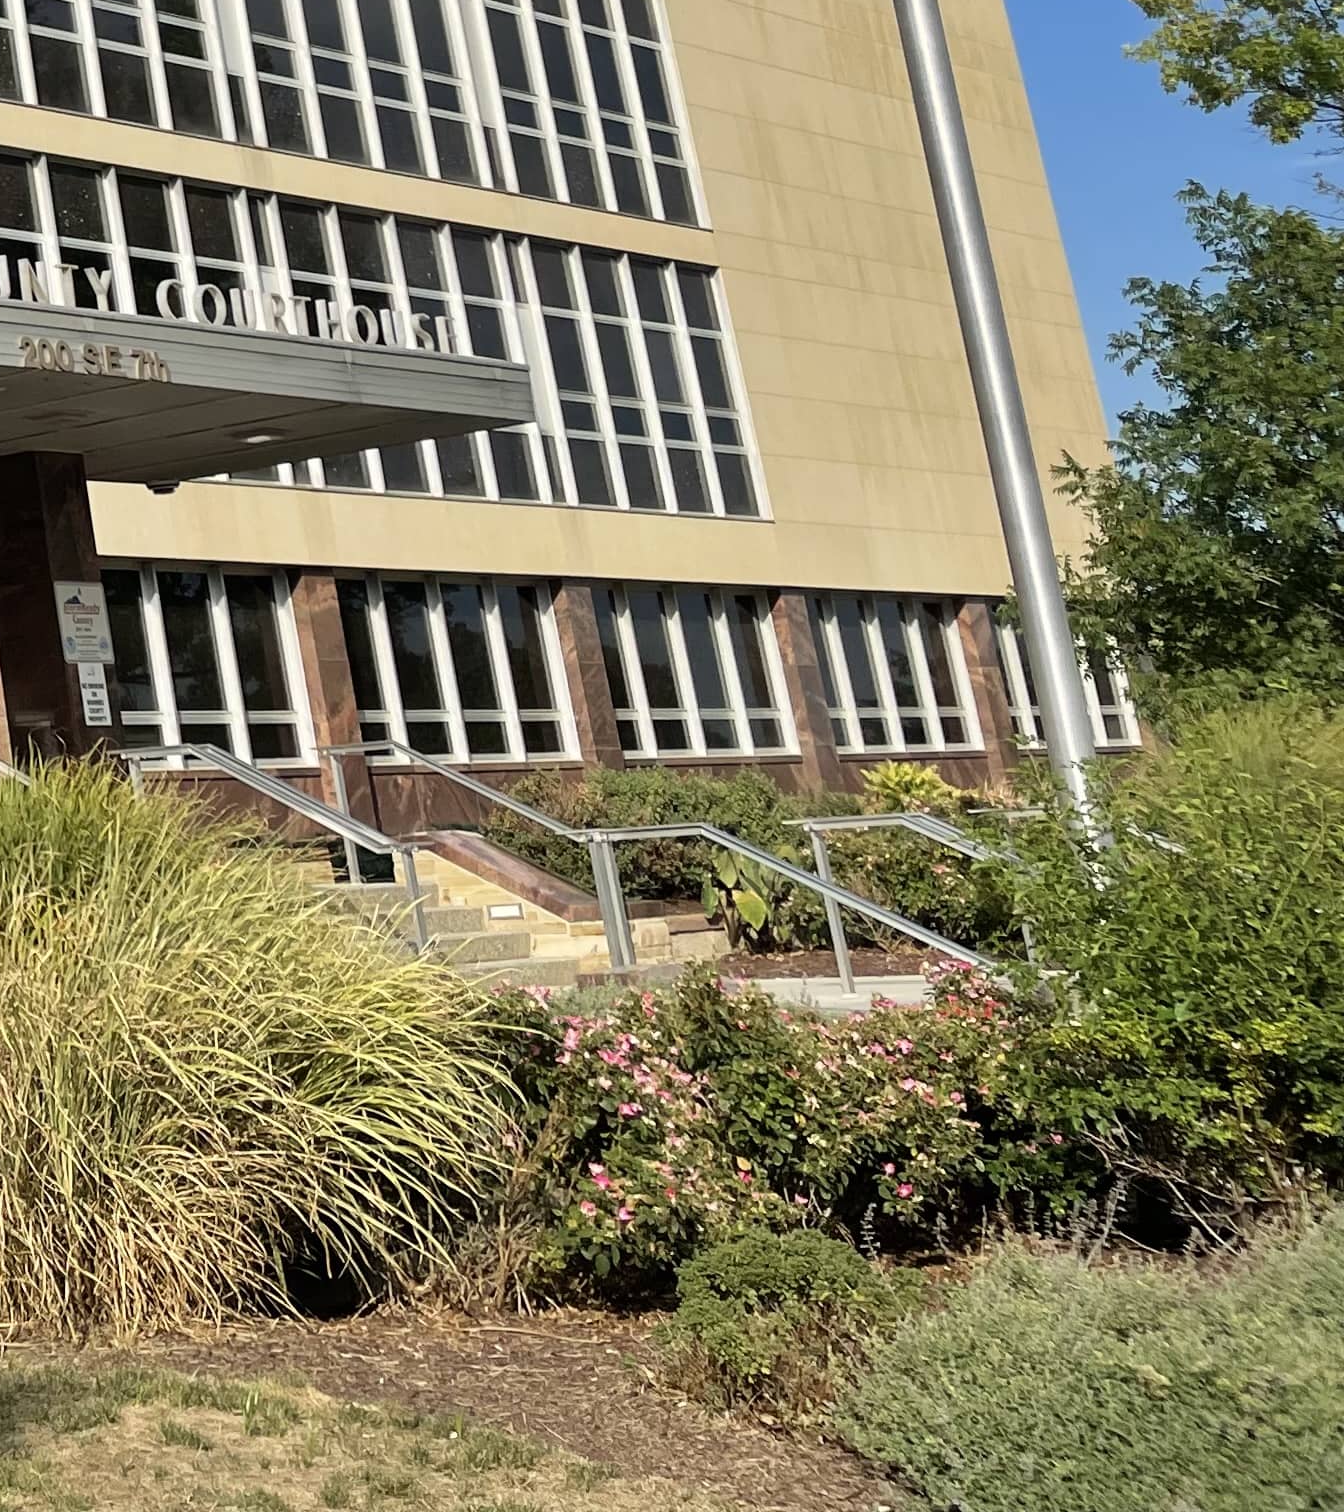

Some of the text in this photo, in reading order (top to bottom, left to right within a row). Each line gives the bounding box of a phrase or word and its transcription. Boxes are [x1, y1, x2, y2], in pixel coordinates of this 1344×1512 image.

[156, 278, 458, 354] COURTHOUSE
[19, 336, 172, 382] 200 SE 7th
